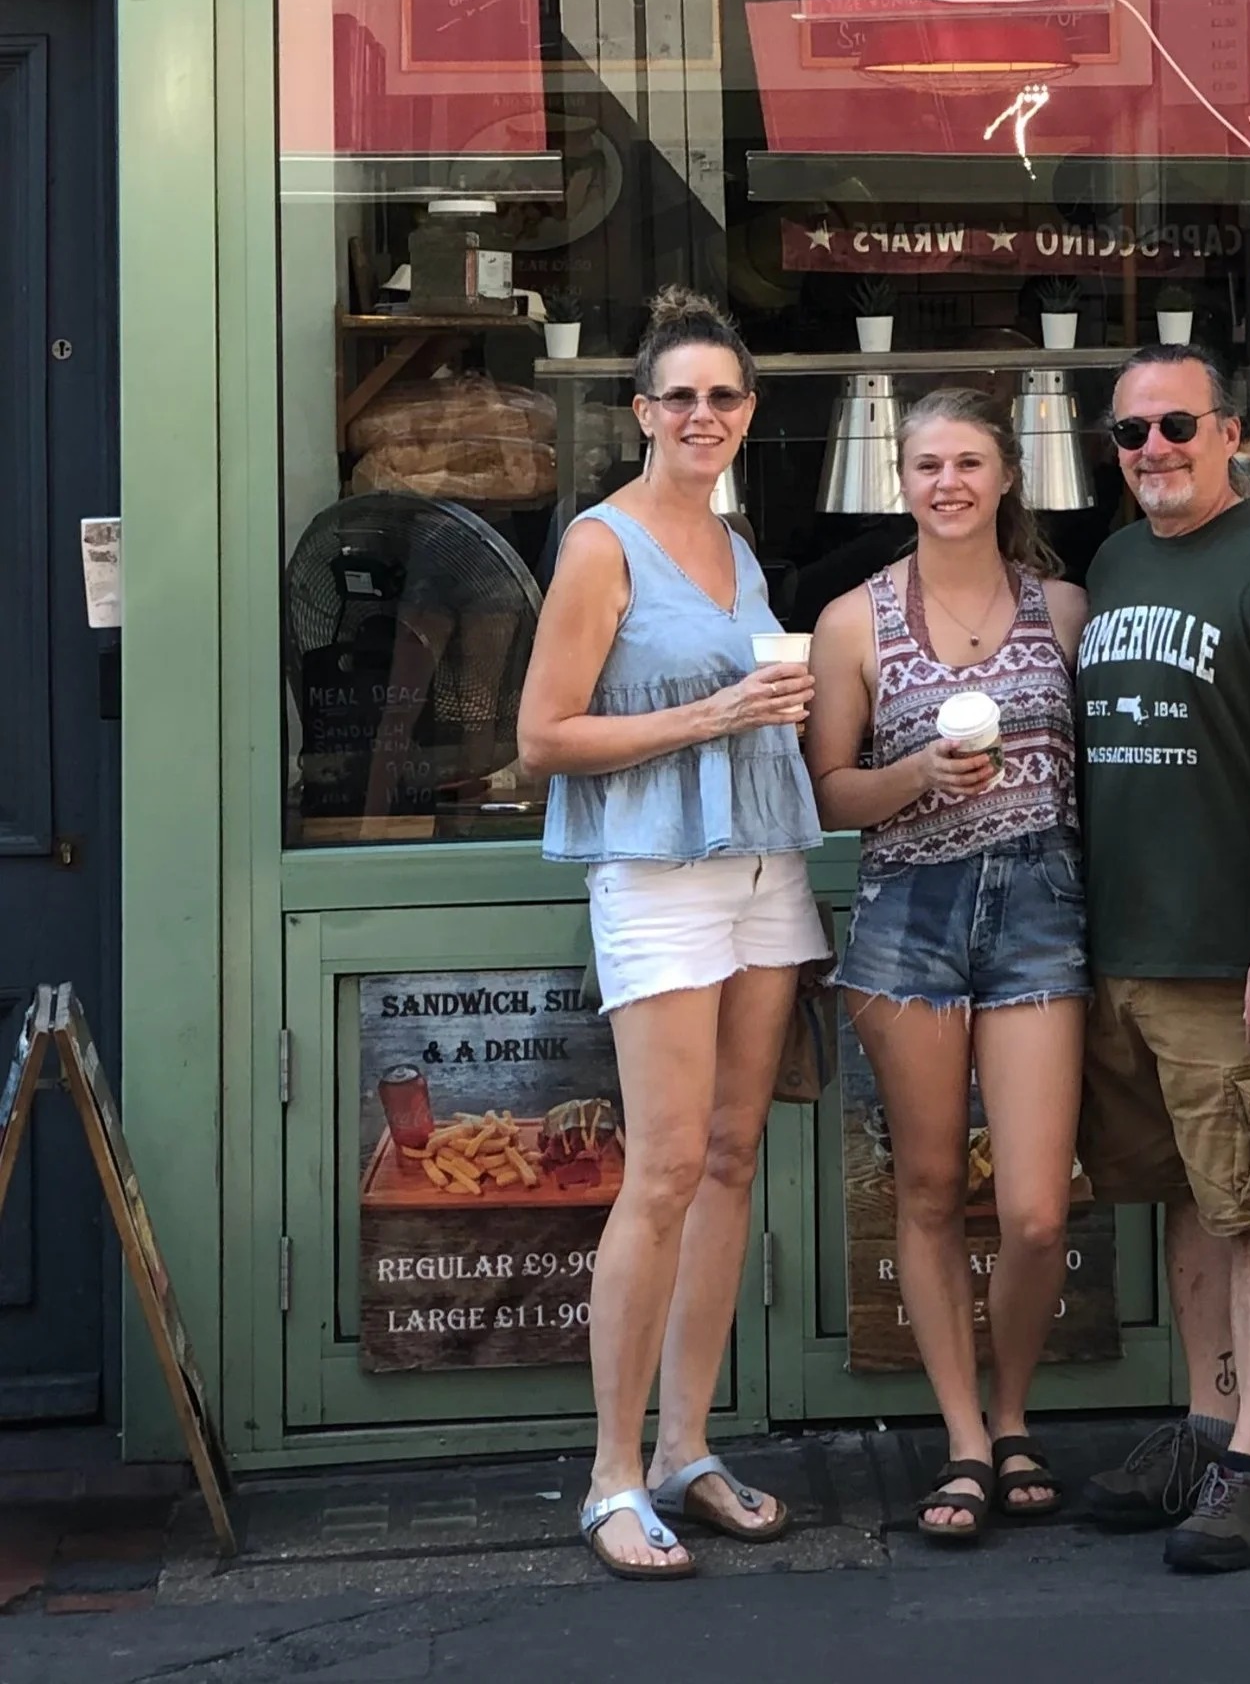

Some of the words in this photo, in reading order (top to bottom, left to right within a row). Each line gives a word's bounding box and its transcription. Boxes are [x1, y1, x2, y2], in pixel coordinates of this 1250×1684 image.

[1087, 700, 1111, 717] EST.
[1153, 700, 1188, 719] 1842
[381, 987, 537, 1019] SANDWICH,
[422, 1041, 444, 1064] &
[454, 1040, 476, 1064] A
[484, 1037, 571, 1064] DRINK
[377, 1253, 514, 1284] REGULAR
[387, 1308, 486, 1334] LARGE
[493, 1302, 591, 1329] £11.90
